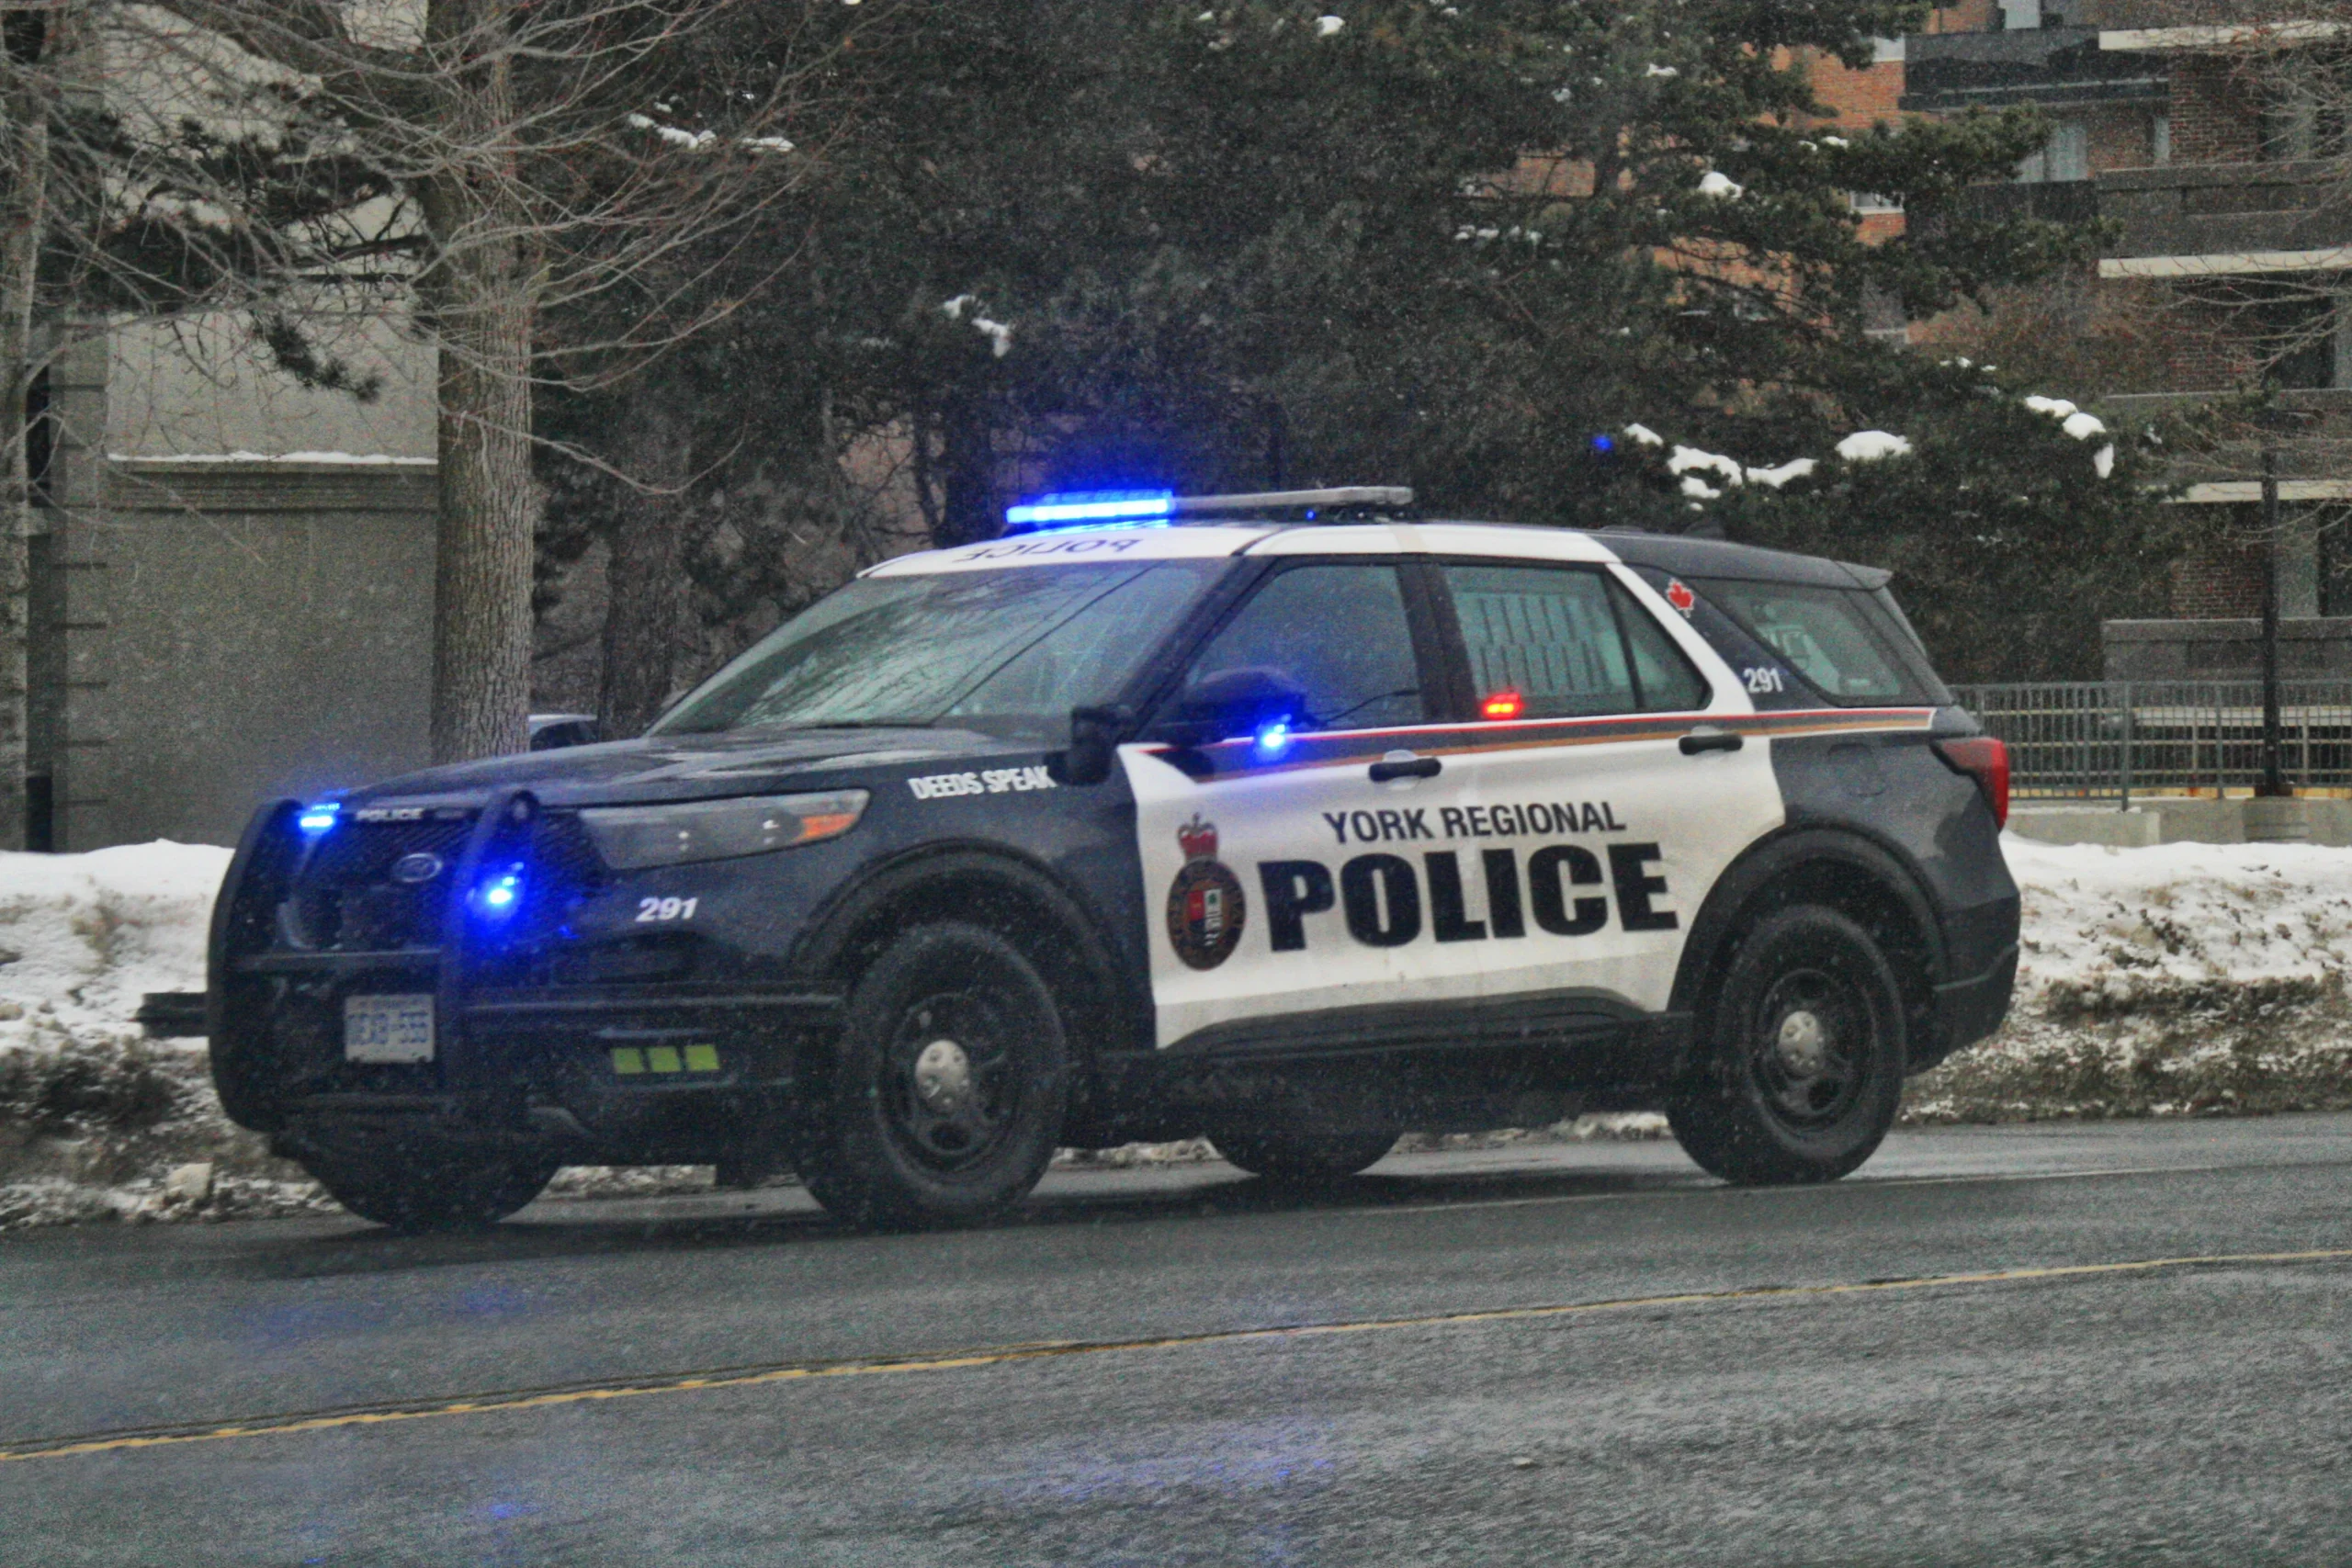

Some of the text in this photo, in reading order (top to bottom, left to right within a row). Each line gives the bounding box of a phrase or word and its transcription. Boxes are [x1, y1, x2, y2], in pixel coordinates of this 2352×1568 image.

[1743, 667, 1783, 694] 291
[908, 766, 1057, 799] DEEDS SPEAK
[1323, 801, 1626, 844] YORK REGIONAL
[635, 897, 698, 921] 291
[1257, 841, 1679, 952] POLICE
